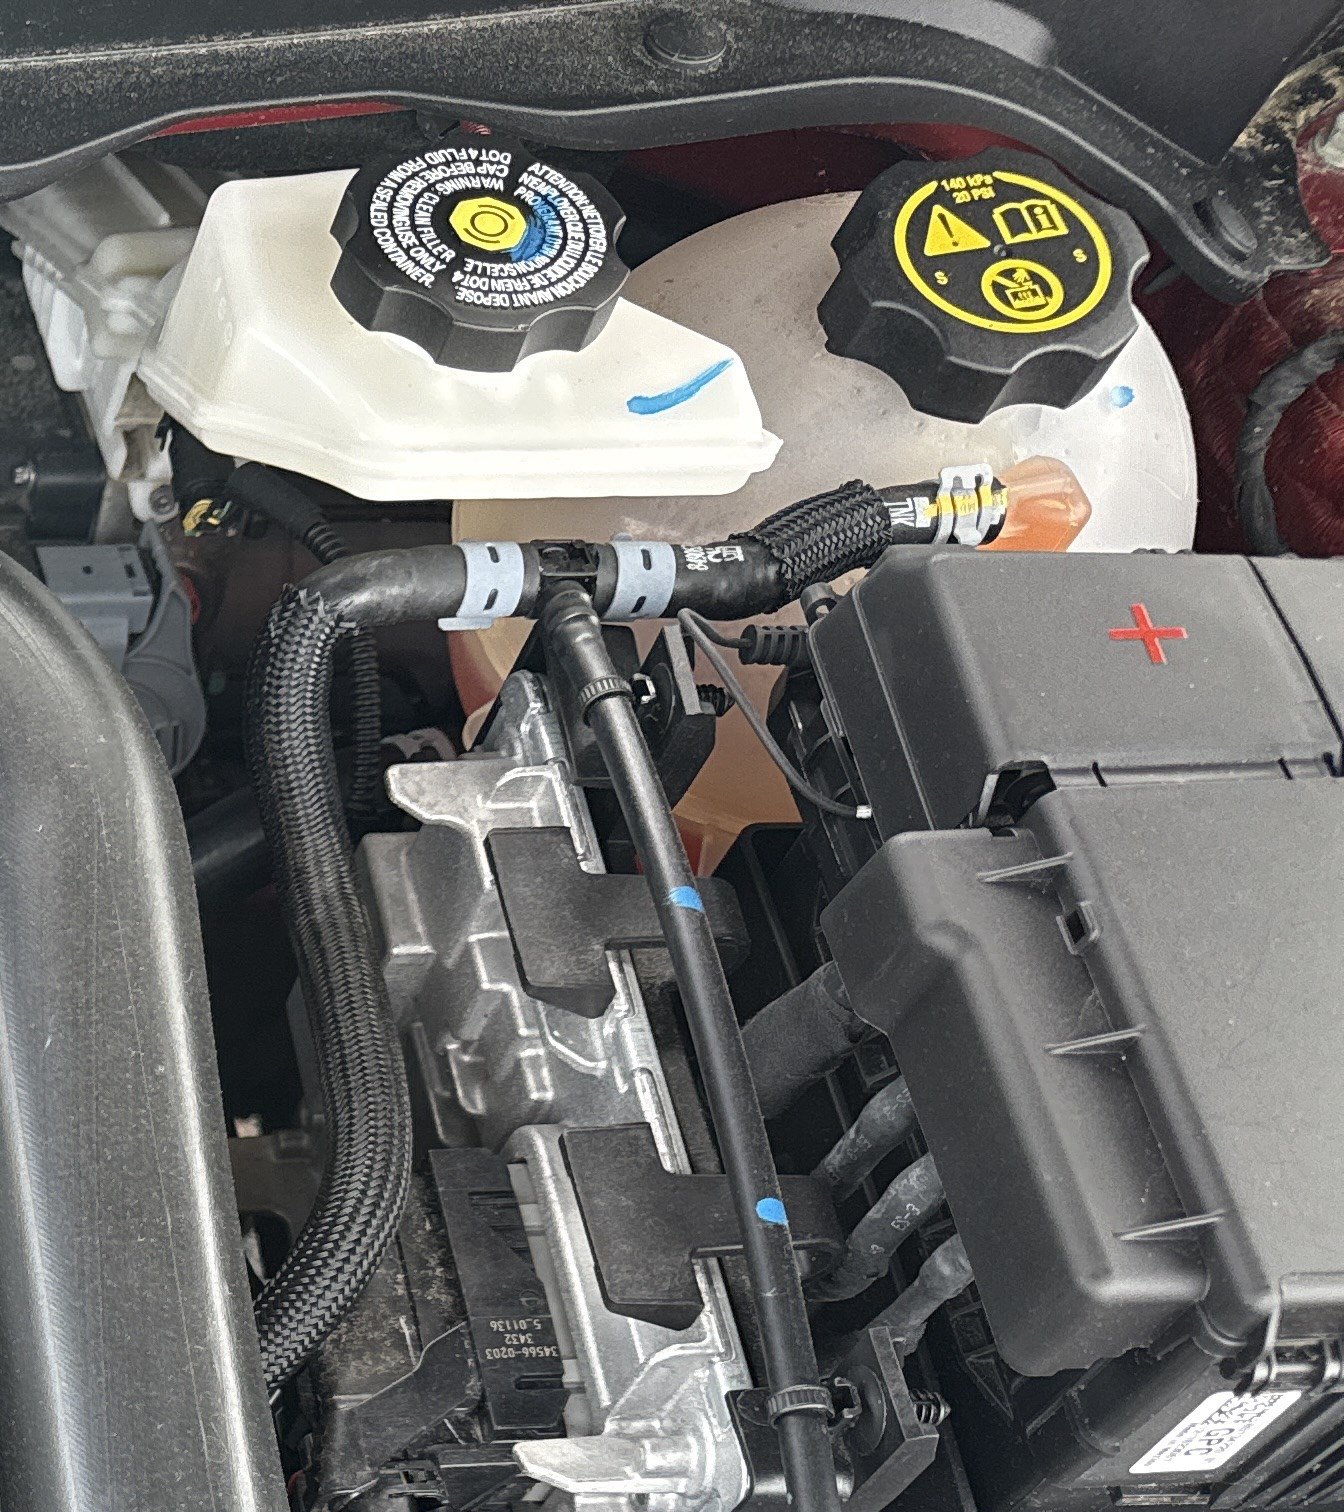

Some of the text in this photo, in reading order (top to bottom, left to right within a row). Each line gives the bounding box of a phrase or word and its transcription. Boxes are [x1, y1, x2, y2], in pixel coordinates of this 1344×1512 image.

[425, 148, 466, 164] FLUID
[480, 149, 511, 164] DOT
[390, 157, 426, 181] FROM
[420, 162, 475, 183] BEFORE
[477, 163, 508, 177] CAP
[941, 176, 966, 191] 140
[952, 186, 996, 204] 20 PSI
[370, 187, 393, 226] SEALED
[415, 193, 439, 225] CLEAN
[417, 228, 455, 262] FILLER
[374, 228, 434, 287] CONTAINER.
[410, 247, 446, 272] ONLY
[504, 1333, 534, 1345] 3432
[485, 1345, 558, 1359] 34566-0203
[1184, 1427, 1235, 1456] GPC
